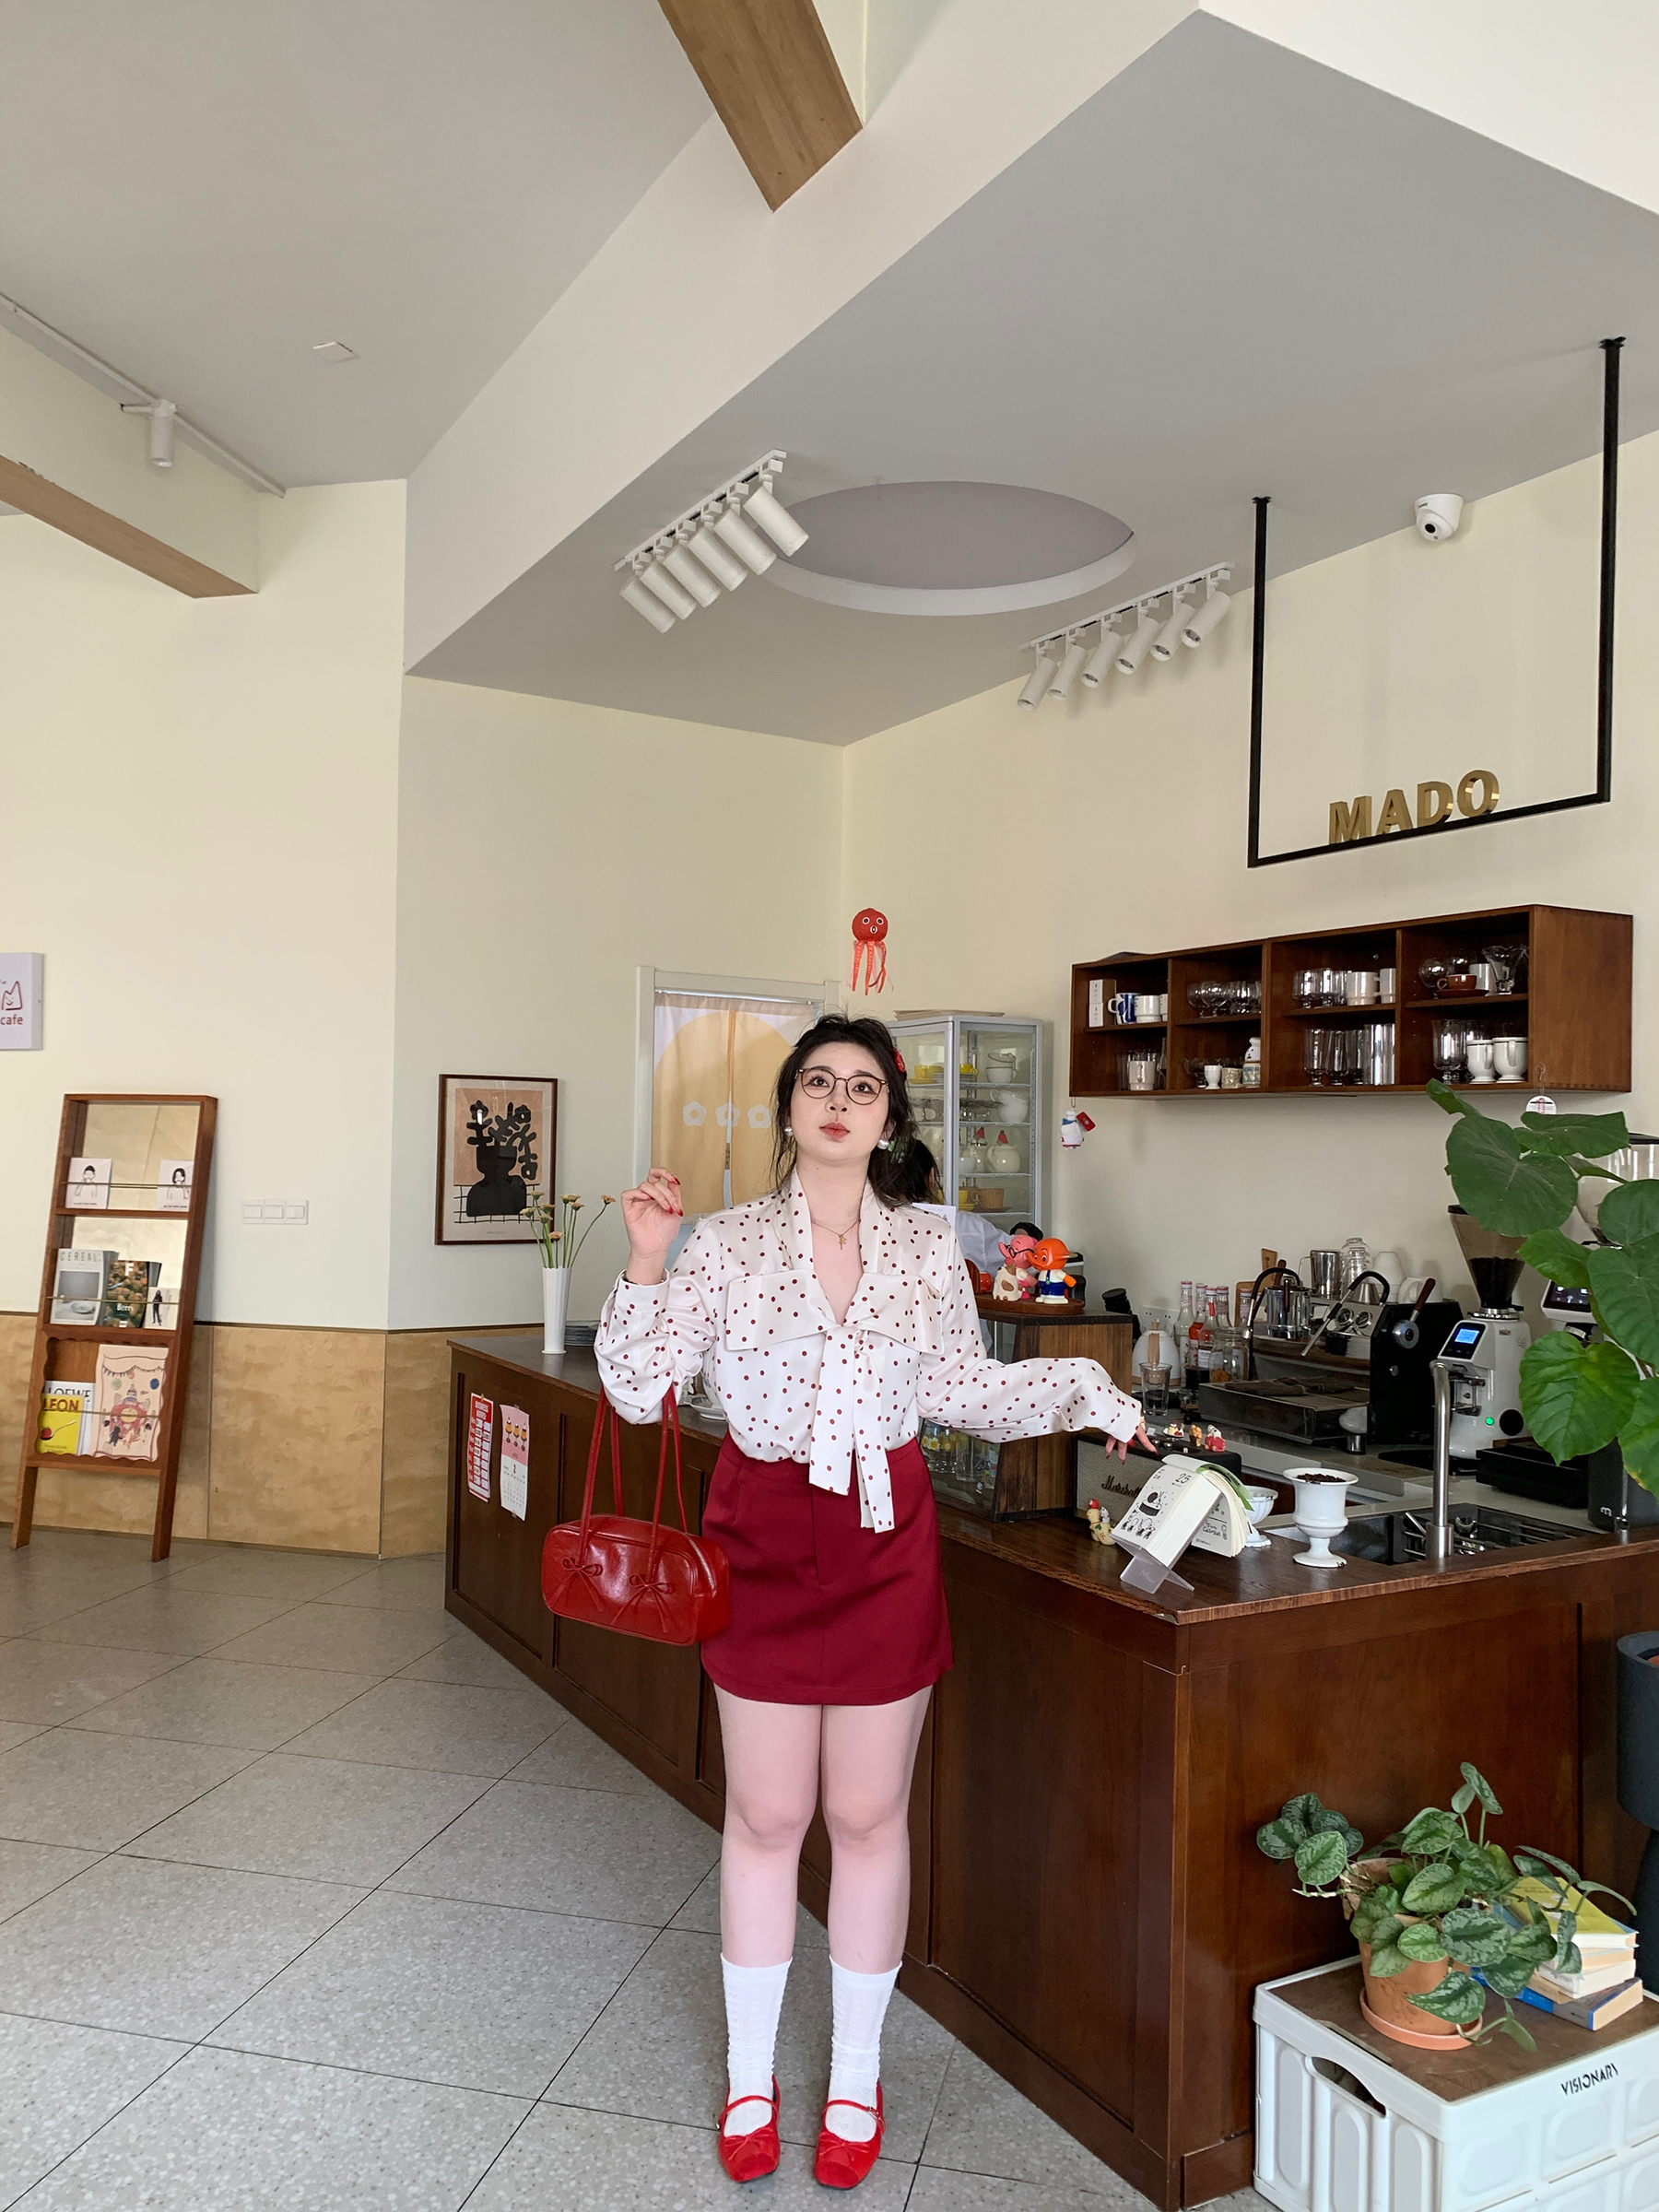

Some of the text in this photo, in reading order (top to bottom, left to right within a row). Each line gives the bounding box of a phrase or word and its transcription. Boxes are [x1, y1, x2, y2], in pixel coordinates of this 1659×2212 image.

[1329, 770, 1500, 845] MADO
[0, 1014, 23, 1025] cafe
[42, 1397, 79, 1412] LEON
